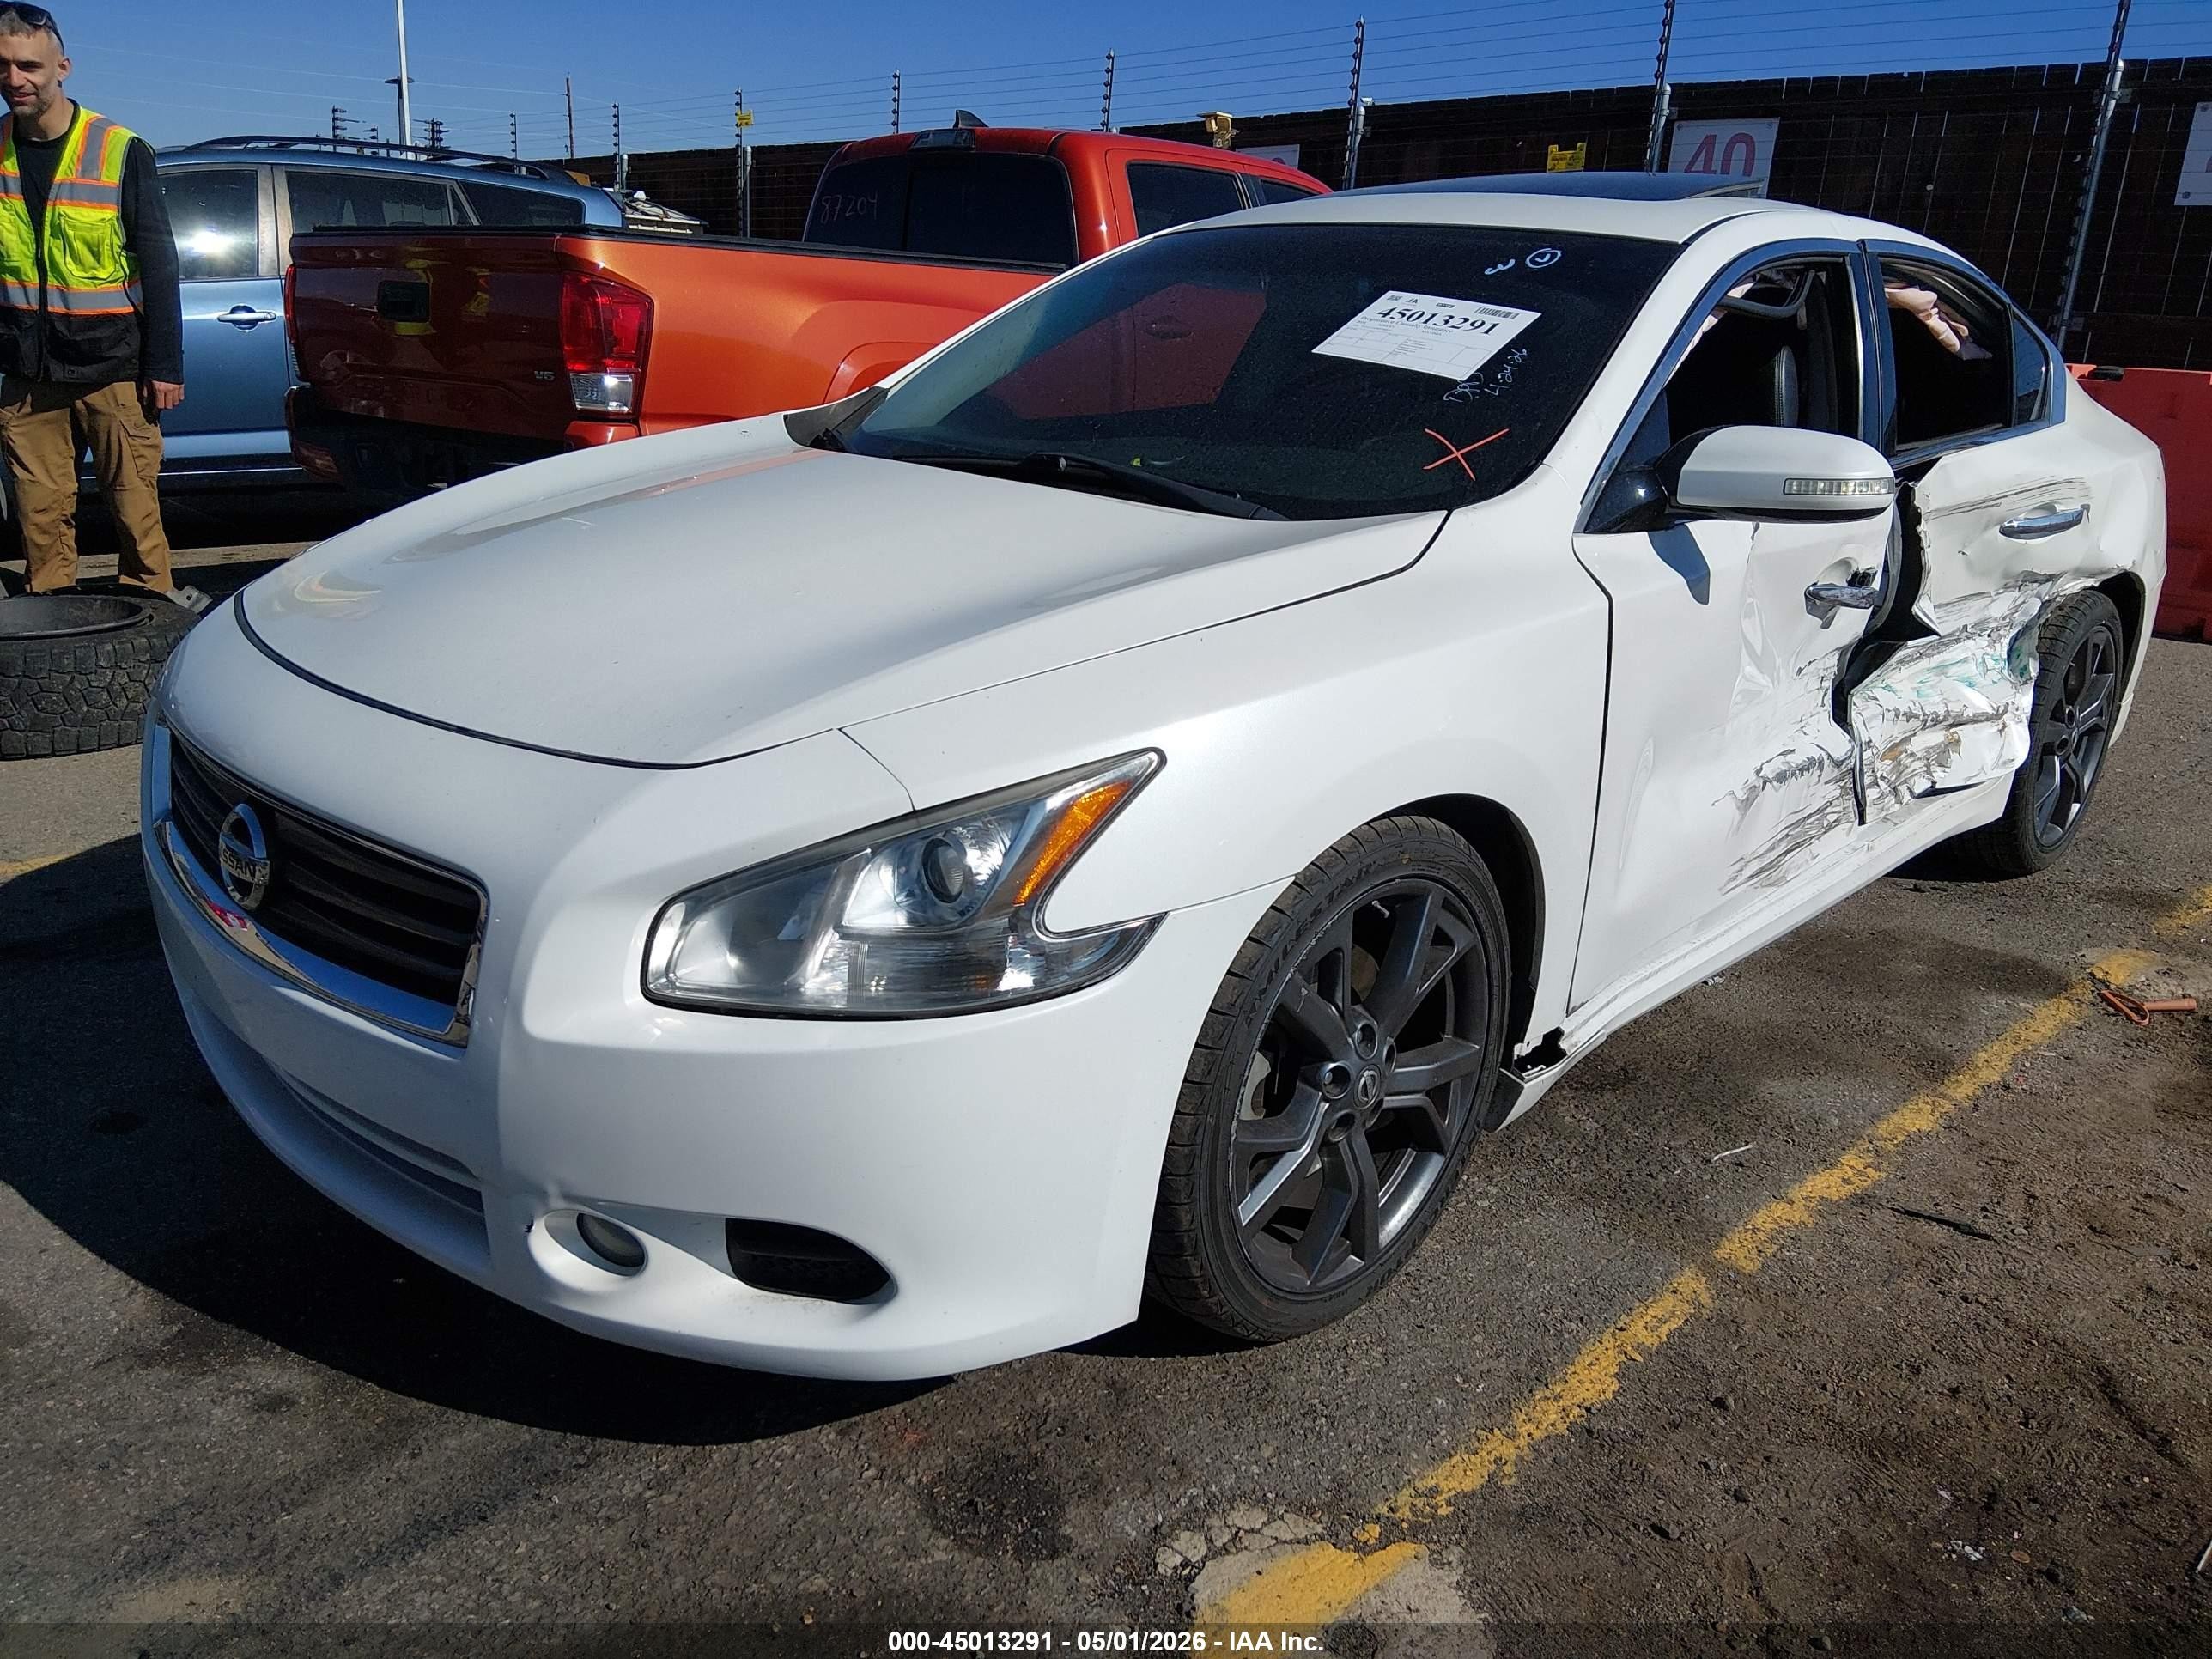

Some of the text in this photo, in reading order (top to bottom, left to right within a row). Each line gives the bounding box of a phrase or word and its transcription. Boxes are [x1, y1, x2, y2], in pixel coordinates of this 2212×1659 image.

[1683, 132, 1756, 177] 40
[820, 190, 878, 224] 87204
[1377, 307, 1501, 336] 45013291
[534, 370, 556, 381] V6
[221, 847, 258, 880] SSAN
